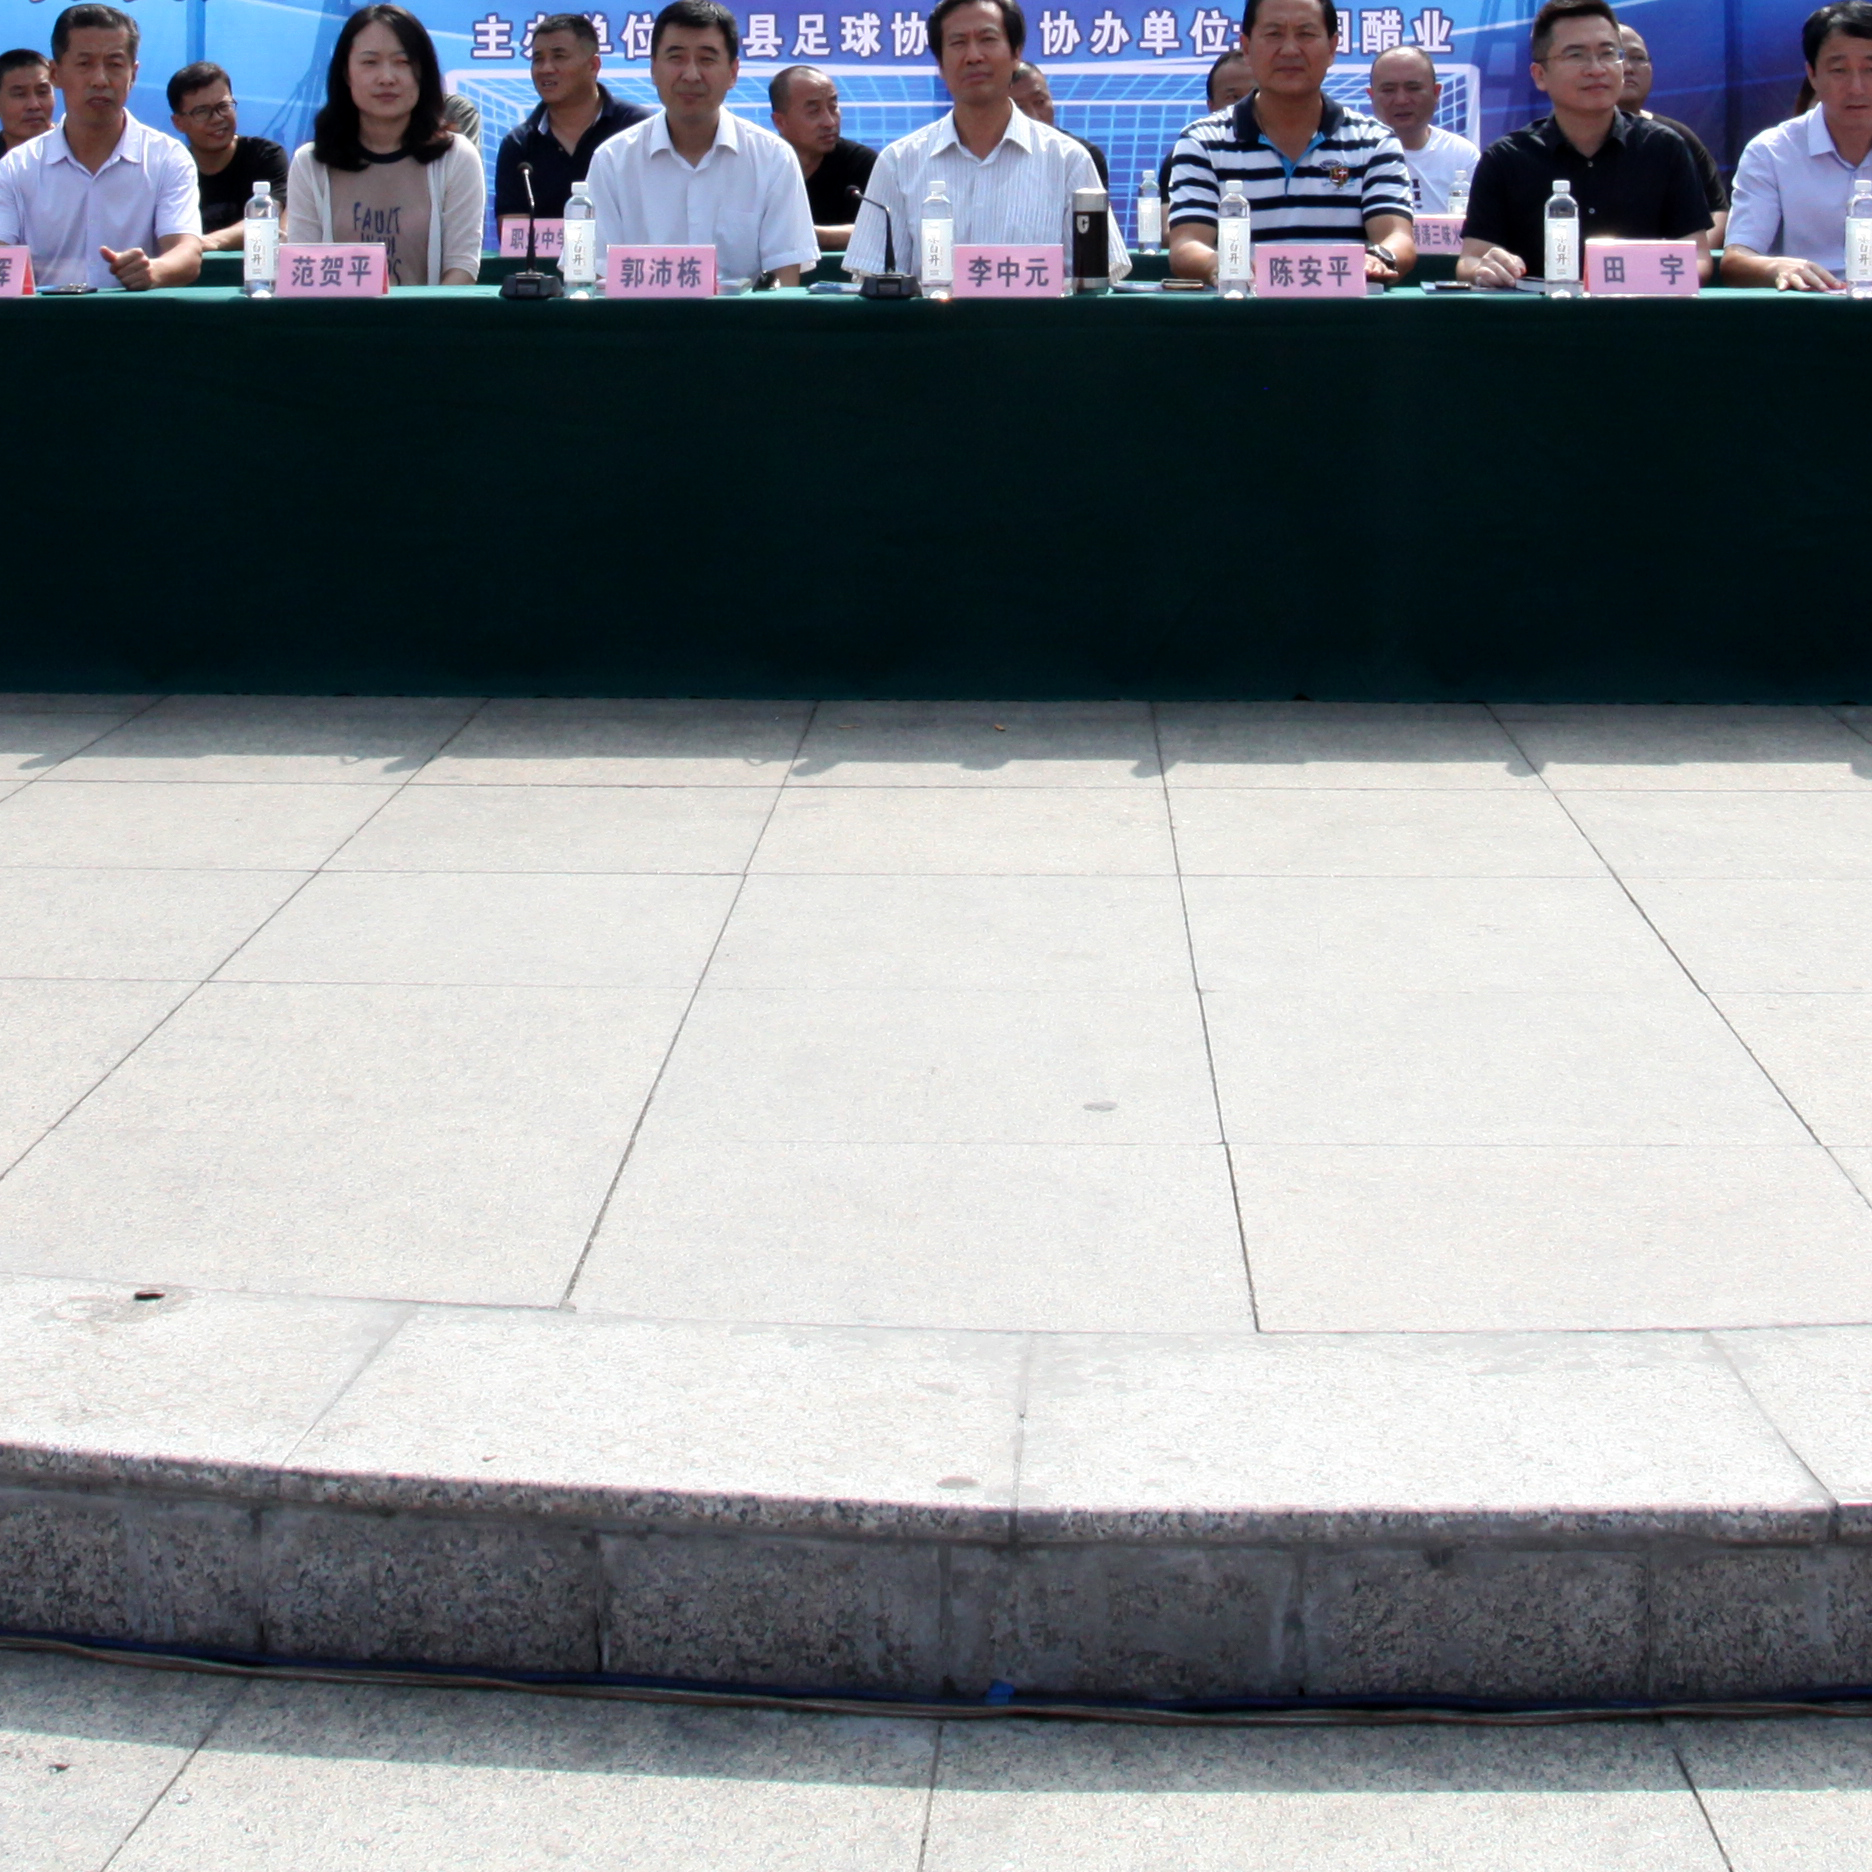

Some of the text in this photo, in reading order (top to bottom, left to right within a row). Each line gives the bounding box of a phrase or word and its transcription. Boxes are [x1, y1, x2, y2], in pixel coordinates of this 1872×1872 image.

[290, 255, 374, 288] 范贺平
[619, 255, 703, 288] 郭沛栋
[966, 255, 1051, 288] 李中元
[1268, 255, 1353, 288] 陈安平
